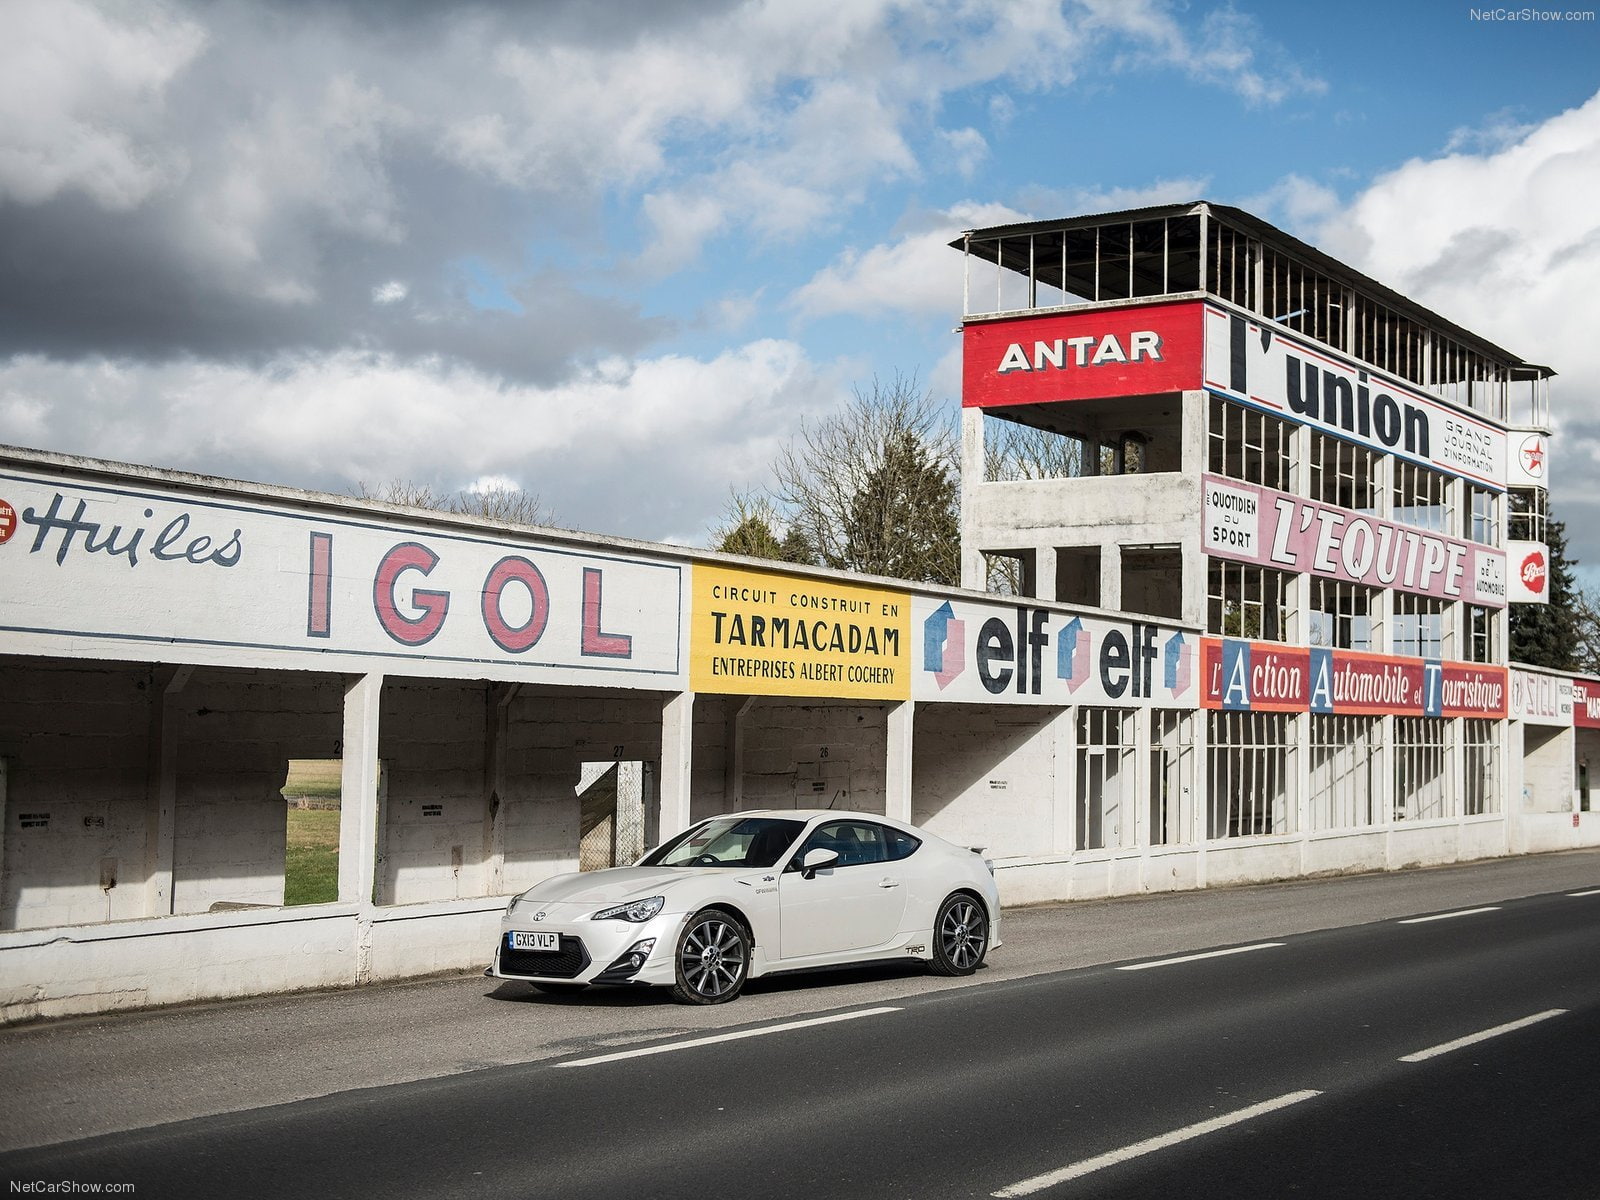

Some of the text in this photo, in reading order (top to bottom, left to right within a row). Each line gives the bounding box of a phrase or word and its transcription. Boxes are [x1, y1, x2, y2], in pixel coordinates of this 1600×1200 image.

[997, 330, 1163, 374] ANTAR
[1445, 420, 1491, 446] GRAND
[1443, 447, 1493, 473] D'INFORMATION
[1444, 434, 1493, 460] JOURNAL
[1212, 490, 1256, 515] QUOTIDIEN
[22, 493, 242, 568] Huiles
[1224, 514, 1239, 525] DU
[1212, 525, 1251, 548] SPORT
[1270, 497, 1467, 596] L'EQUIPE
[1486, 558, 1495, 567] ET
[306, 531, 633, 660] IGOL
[712, 585, 899, 618] CIRCUIT CONSTRUIT EN
[710, 611, 900, 657] TARMACADAM
[976, 606, 1050, 695] elf
[1099, 622, 1158, 700] elf
[712, 656, 896, 685] ENTREPRISES ALBERT COCHERY
[1310, 655, 1409, 708] Automobile
[1424, 663, 1502, 713] Touristique
[613, 745, 625, 758] 27
[819, 747, 830, 758] 26
[516, 933, 556, 948] GX13 VLP
